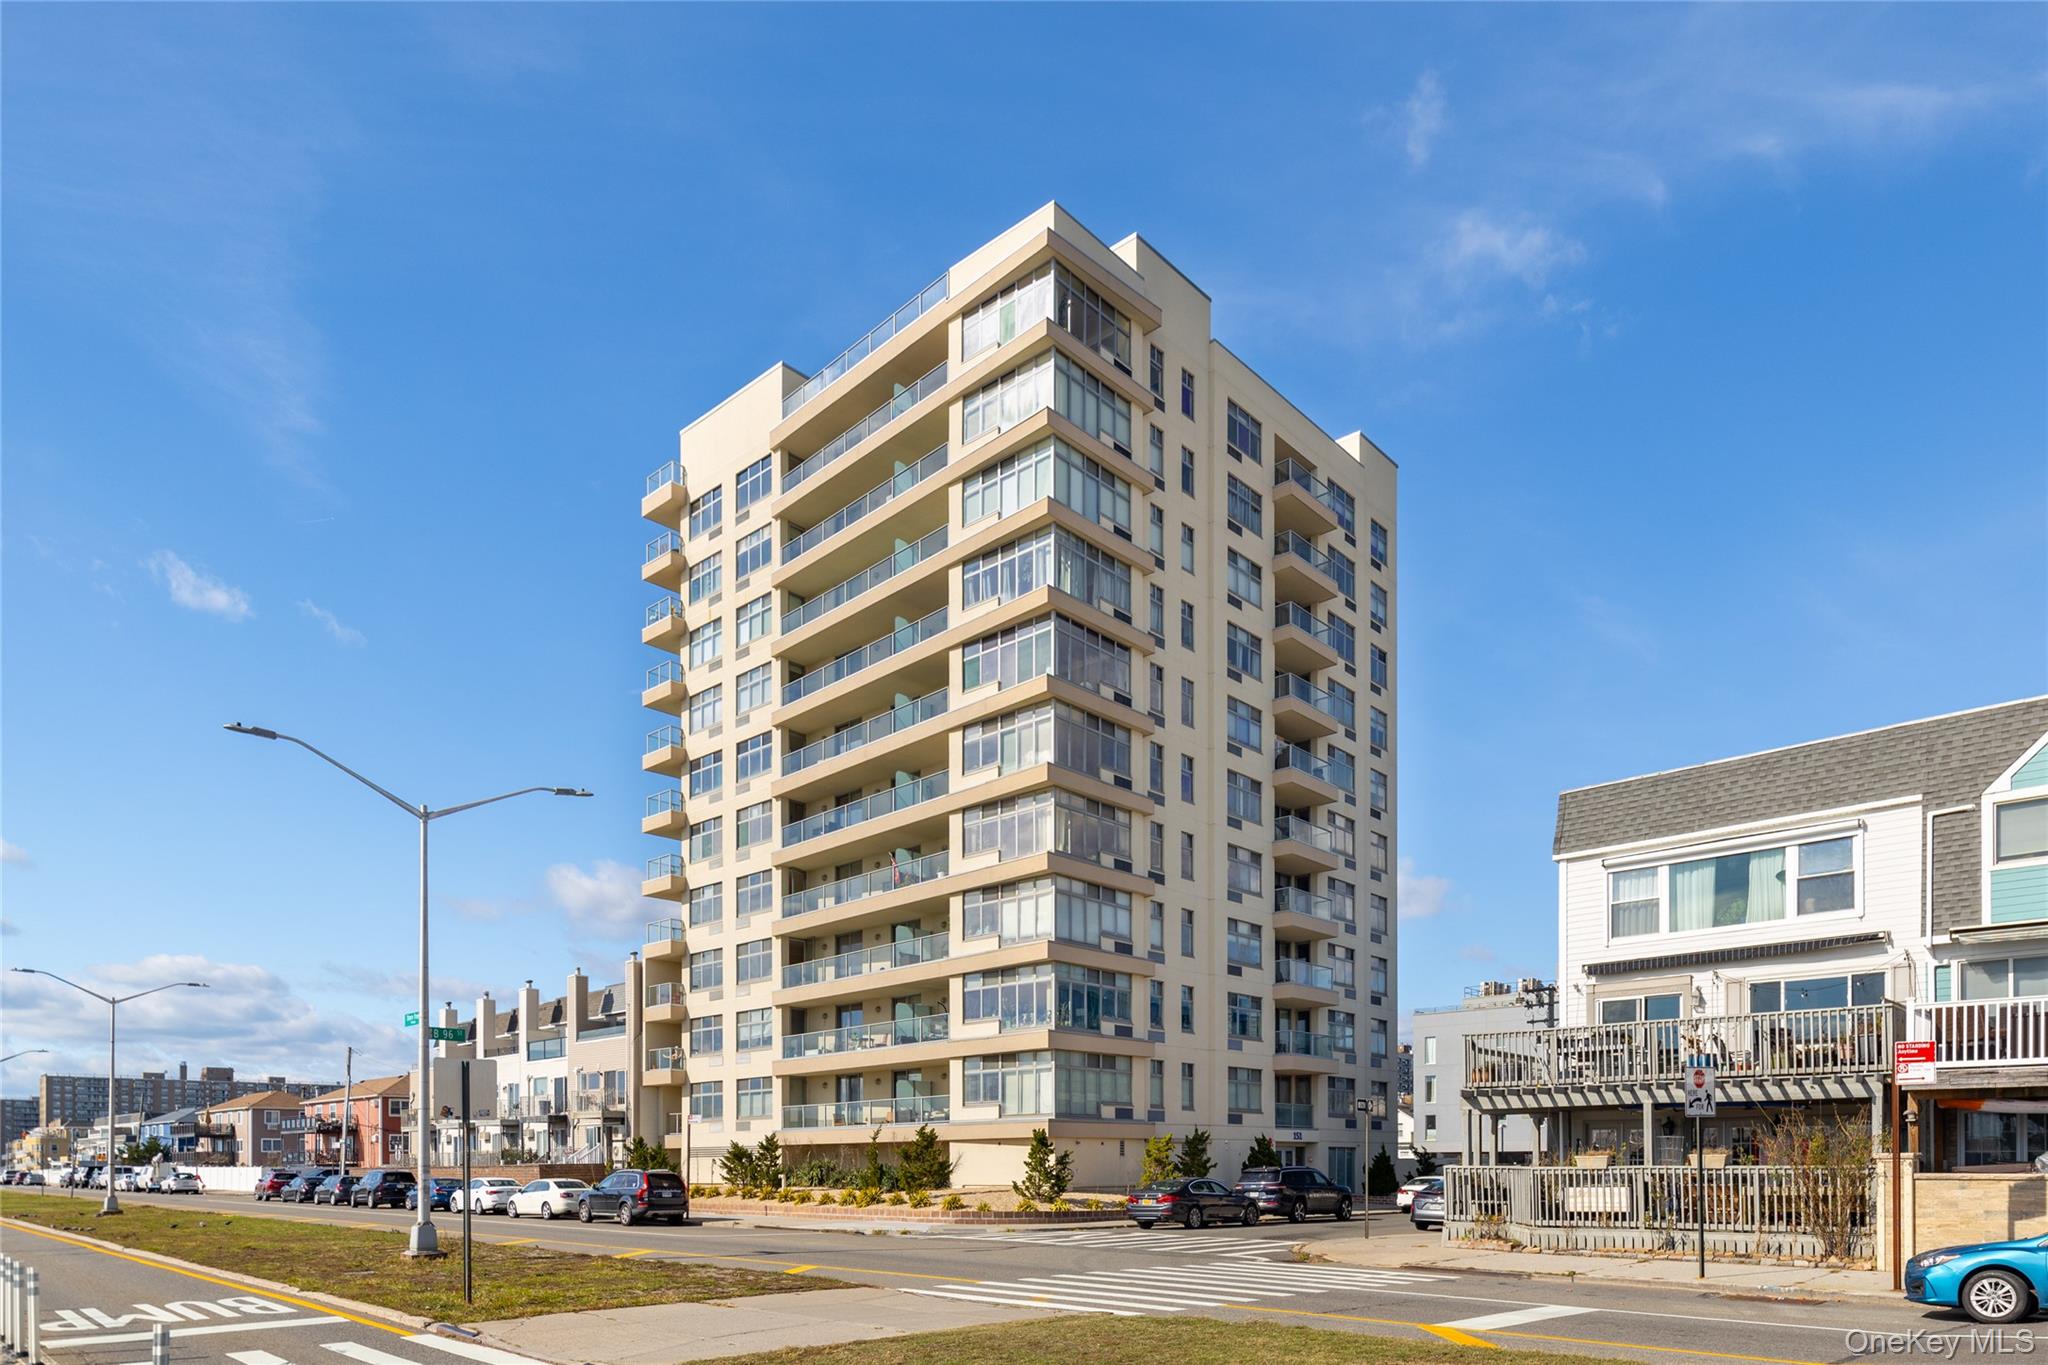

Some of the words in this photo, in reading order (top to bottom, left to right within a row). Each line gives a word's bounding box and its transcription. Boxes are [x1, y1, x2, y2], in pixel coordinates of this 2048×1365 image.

[443, 1029, 454, 1040] 96
[1293, 1131, 1302, 1140] 151
[39, 1296, 298, 1332] BUMP
